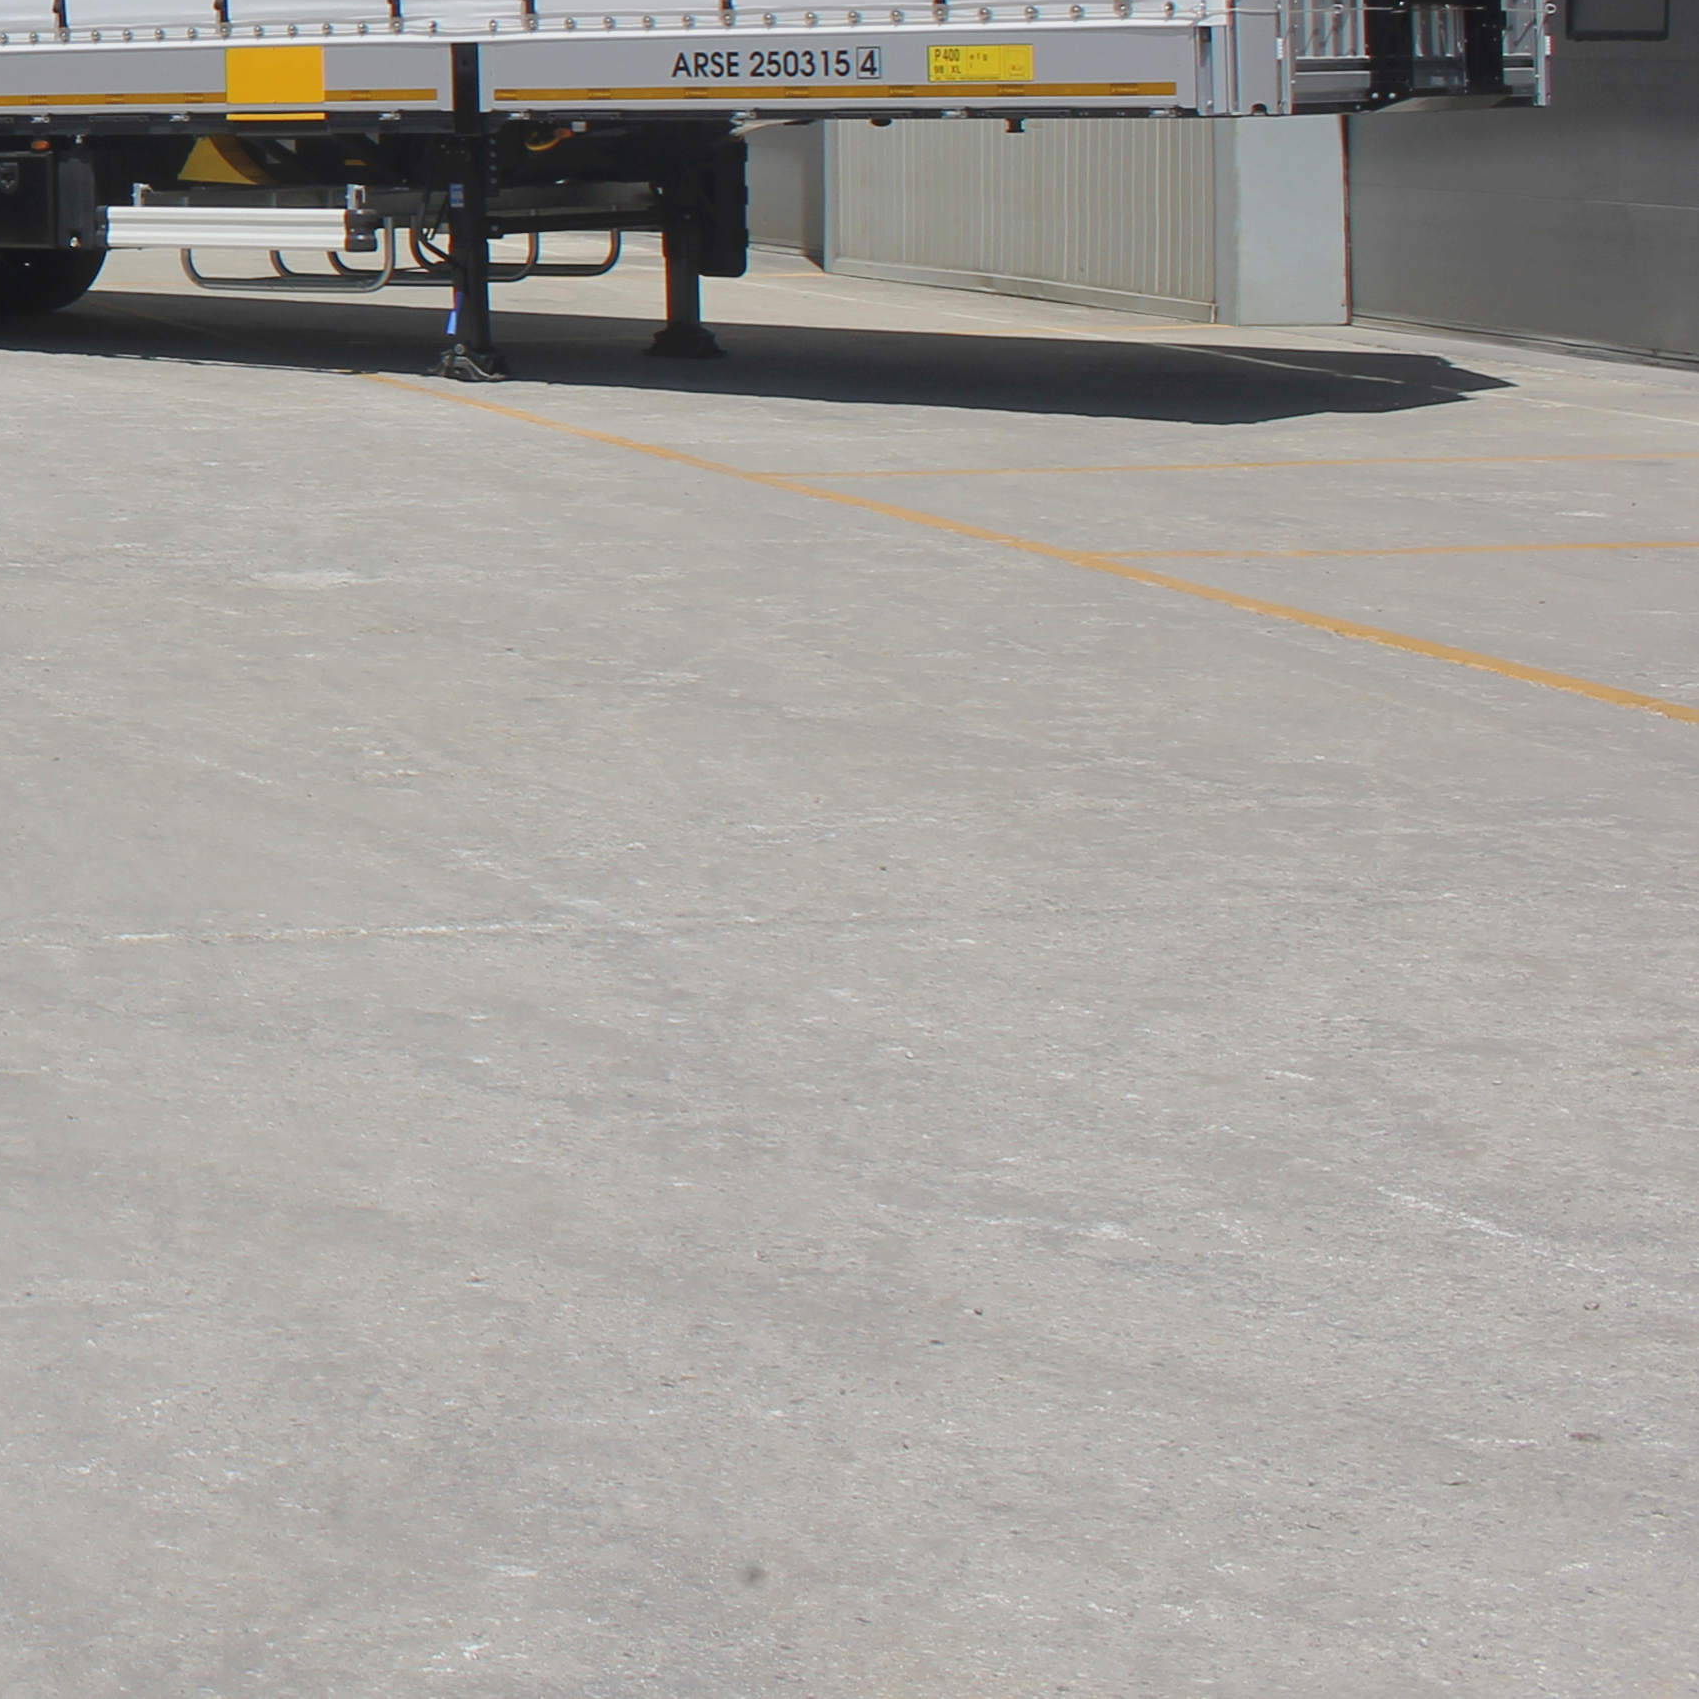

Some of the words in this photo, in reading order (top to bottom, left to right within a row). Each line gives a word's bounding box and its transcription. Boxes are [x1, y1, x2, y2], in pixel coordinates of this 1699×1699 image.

[671, 52, 740, 78] ARSE
[750, 50, 850, 77] 250315
[860, 50, 877, 76] 4
